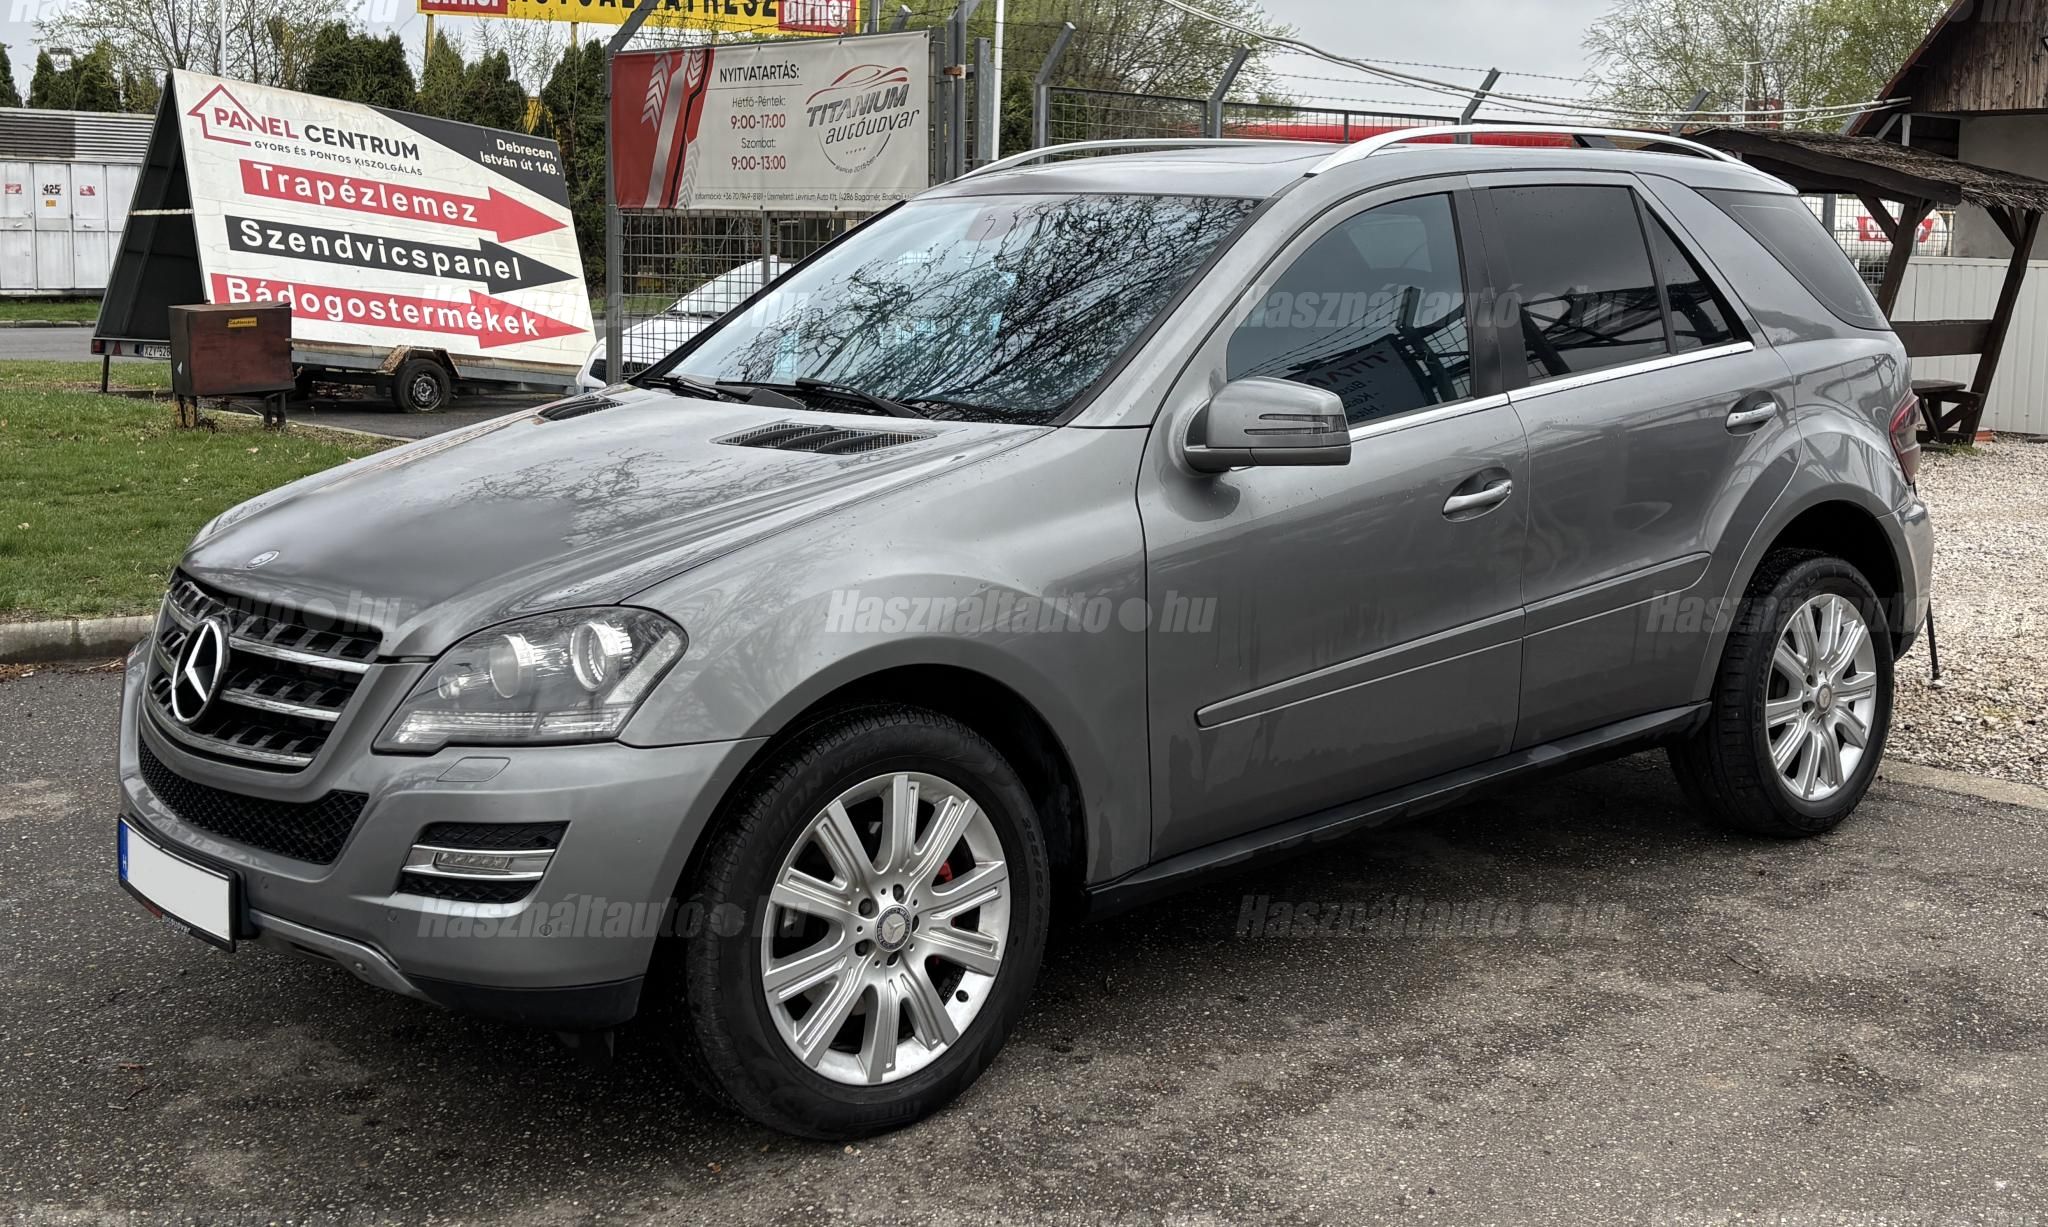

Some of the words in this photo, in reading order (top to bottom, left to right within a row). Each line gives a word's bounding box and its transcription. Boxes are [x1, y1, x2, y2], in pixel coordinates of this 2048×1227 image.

[719, 60, 800, 82] NYITVATARTÁS:
[732, 95, 786, 107] Hétfő-Péntek:
[806, 84, 909, 127] TITANIUM
[731, 113, 786, 129] 9:00-17:00
[213, 107, 299, 139] PANEL
[304, 125, 420, 161] CENTRUM
[741, 137, 776, 149] Szombat:
[254, 141, 291, 154] GYORS
[294, 146, 306, 156] ÉS
[310, 150, 352, 164] PONTOS
[354, 155, 423, 176] KISZOLGÁLÁS
[496, 138, 557, 161] Debrecen,
[480, 151, 518, 168] István
[520, 158, 534, 171] út
[535, 161, 560, 176] 149.
[731, 155, 786, 170] 9:00-13:00
[43, 184, 61, 194] 425
[251, 163, 479, 223] Trapézlemez
[240, 218, 523, 281] Szendvicspanel
[225, 276, 540, 337] Bádogostermékek
